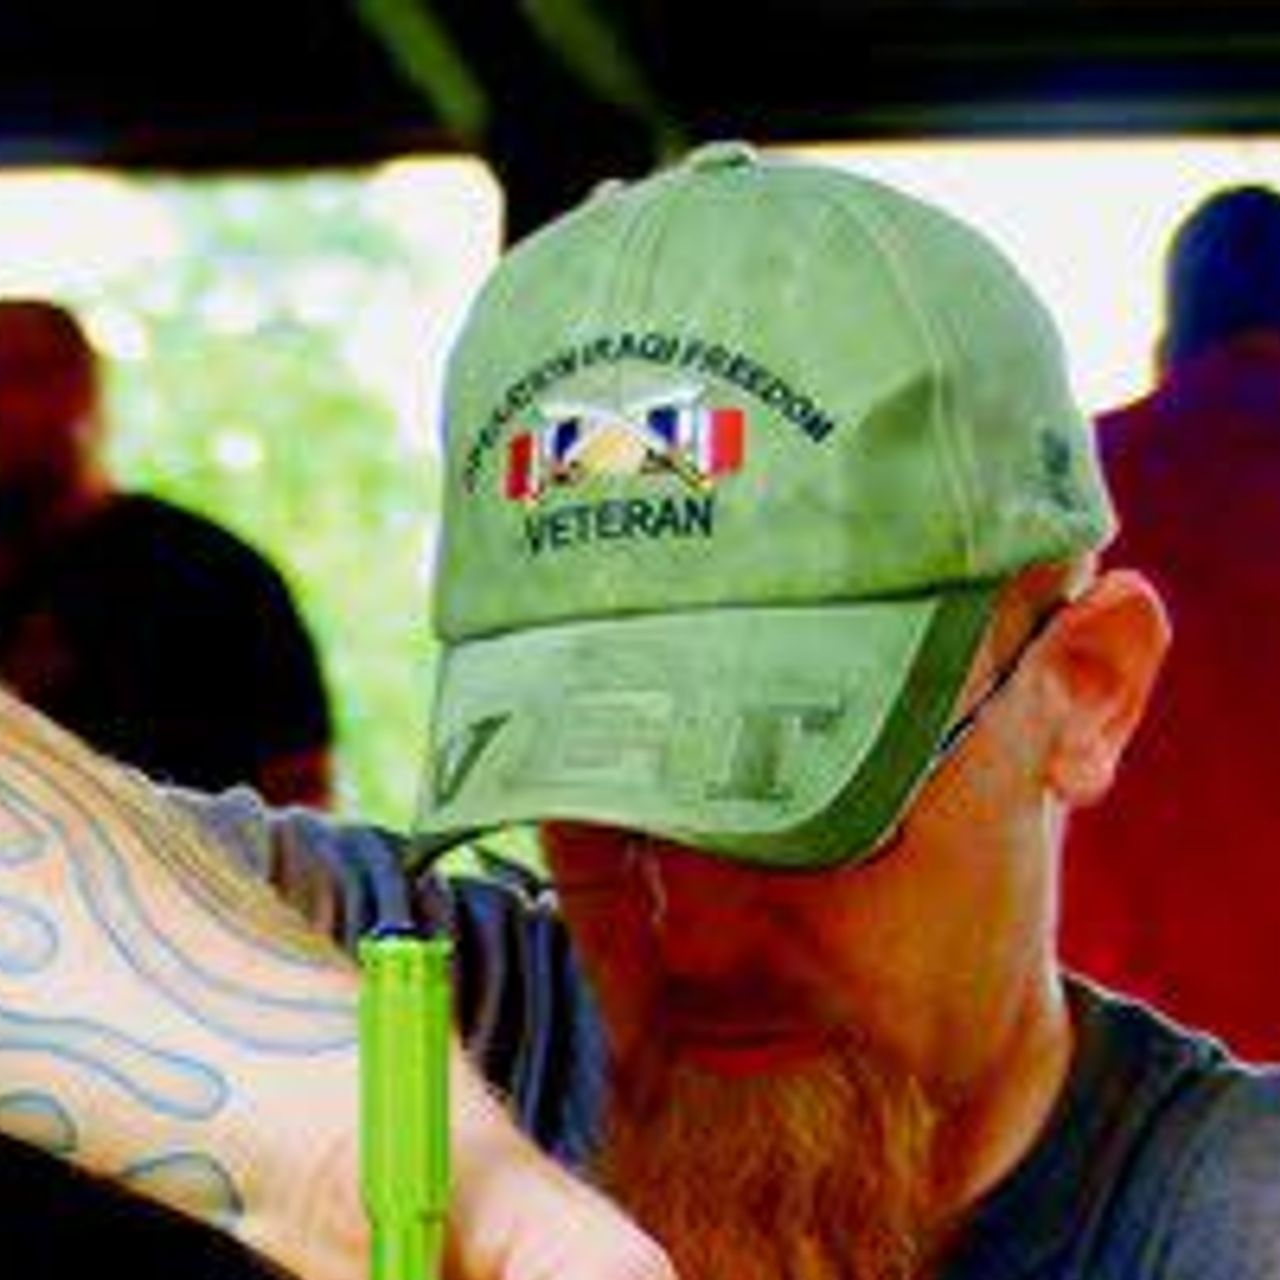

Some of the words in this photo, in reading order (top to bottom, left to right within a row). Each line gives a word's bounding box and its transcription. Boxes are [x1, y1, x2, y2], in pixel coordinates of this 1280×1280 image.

[581, 332, 679, 366] IRAQI
[681, 336, 834, 444] FREEDOM
[523, 496, 715, 555] VETERAN
